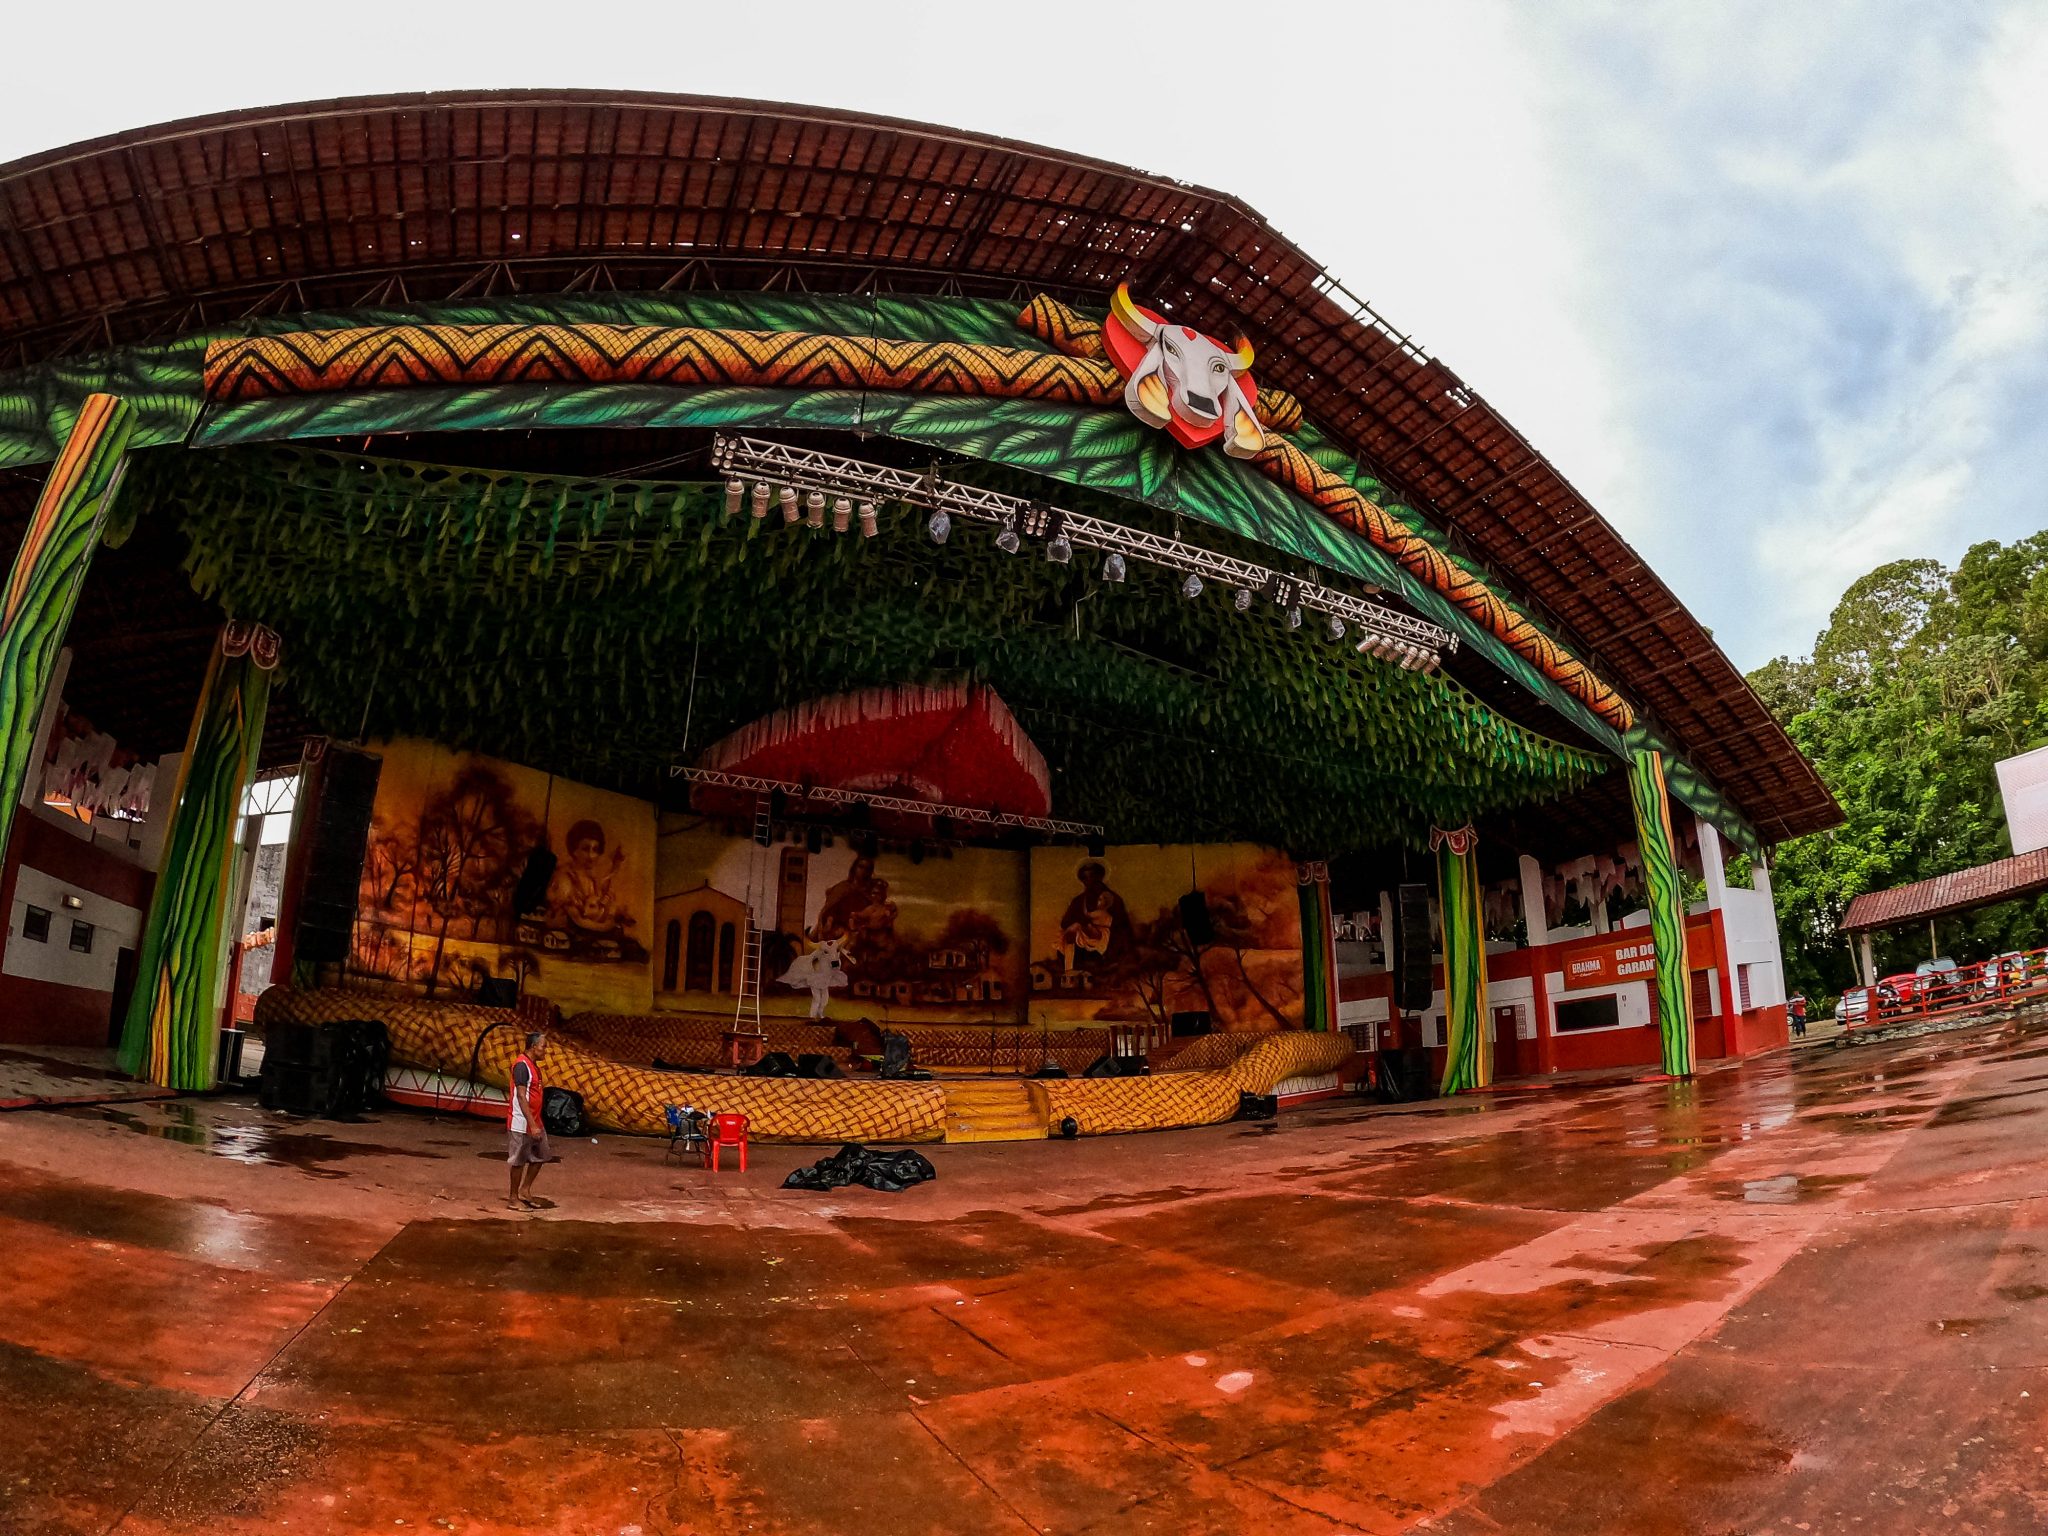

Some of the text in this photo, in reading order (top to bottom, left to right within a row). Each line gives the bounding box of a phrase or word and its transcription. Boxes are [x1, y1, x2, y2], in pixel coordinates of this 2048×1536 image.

[1616, 943, 1654, 960] BAR DO
[1572, 960, 1601, 974] BRAHMA
[1617, 959, 1655, 975] GARAN
